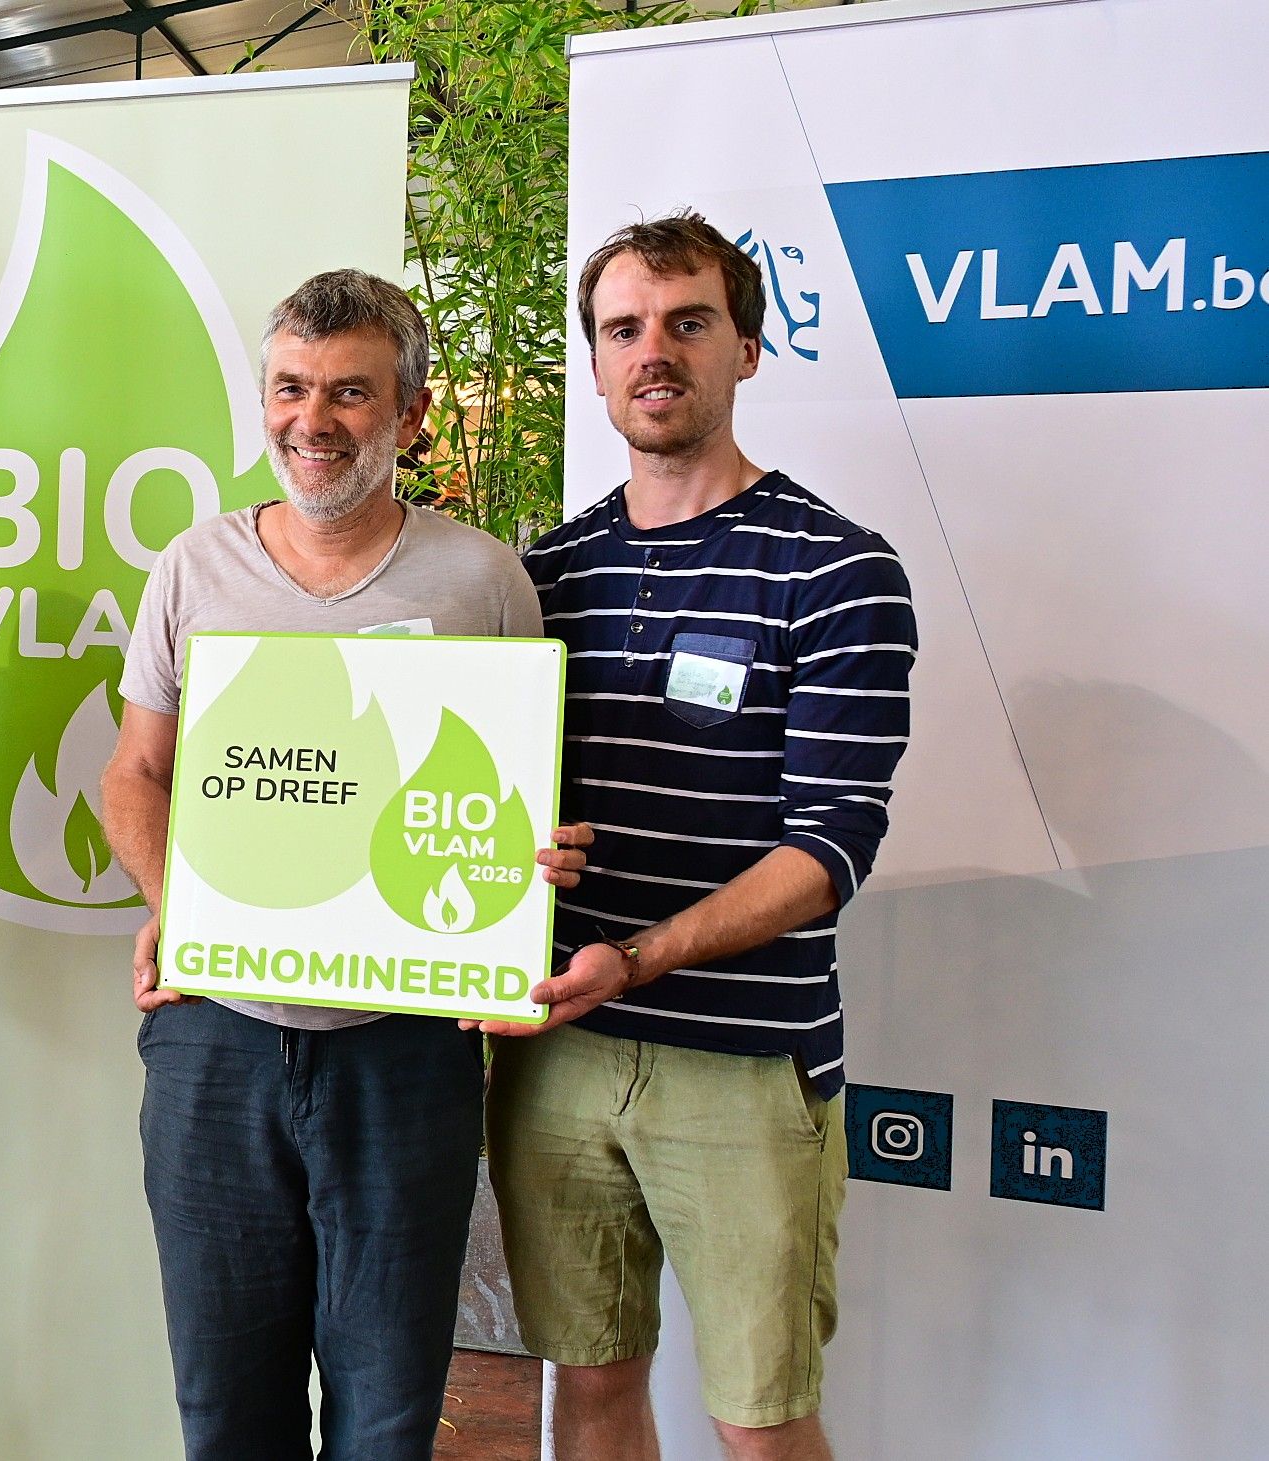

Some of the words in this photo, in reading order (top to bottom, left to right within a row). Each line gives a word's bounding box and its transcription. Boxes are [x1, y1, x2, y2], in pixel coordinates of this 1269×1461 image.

[905, 237, 1269, 323] VLAM.b
[224, 745, 337, 773] SAMEN
[201, 776, 246, 800] OP
[255, 777, 359, 805] DREEF
[403, 790, 497, 832] BIO
[403, 832, 495, 860] VLAM
[467, 865, 523, 884] 2026
[174, 942, 529, 1002] GENOMINEERD
[1022, 1131, 1073, 1179] in
